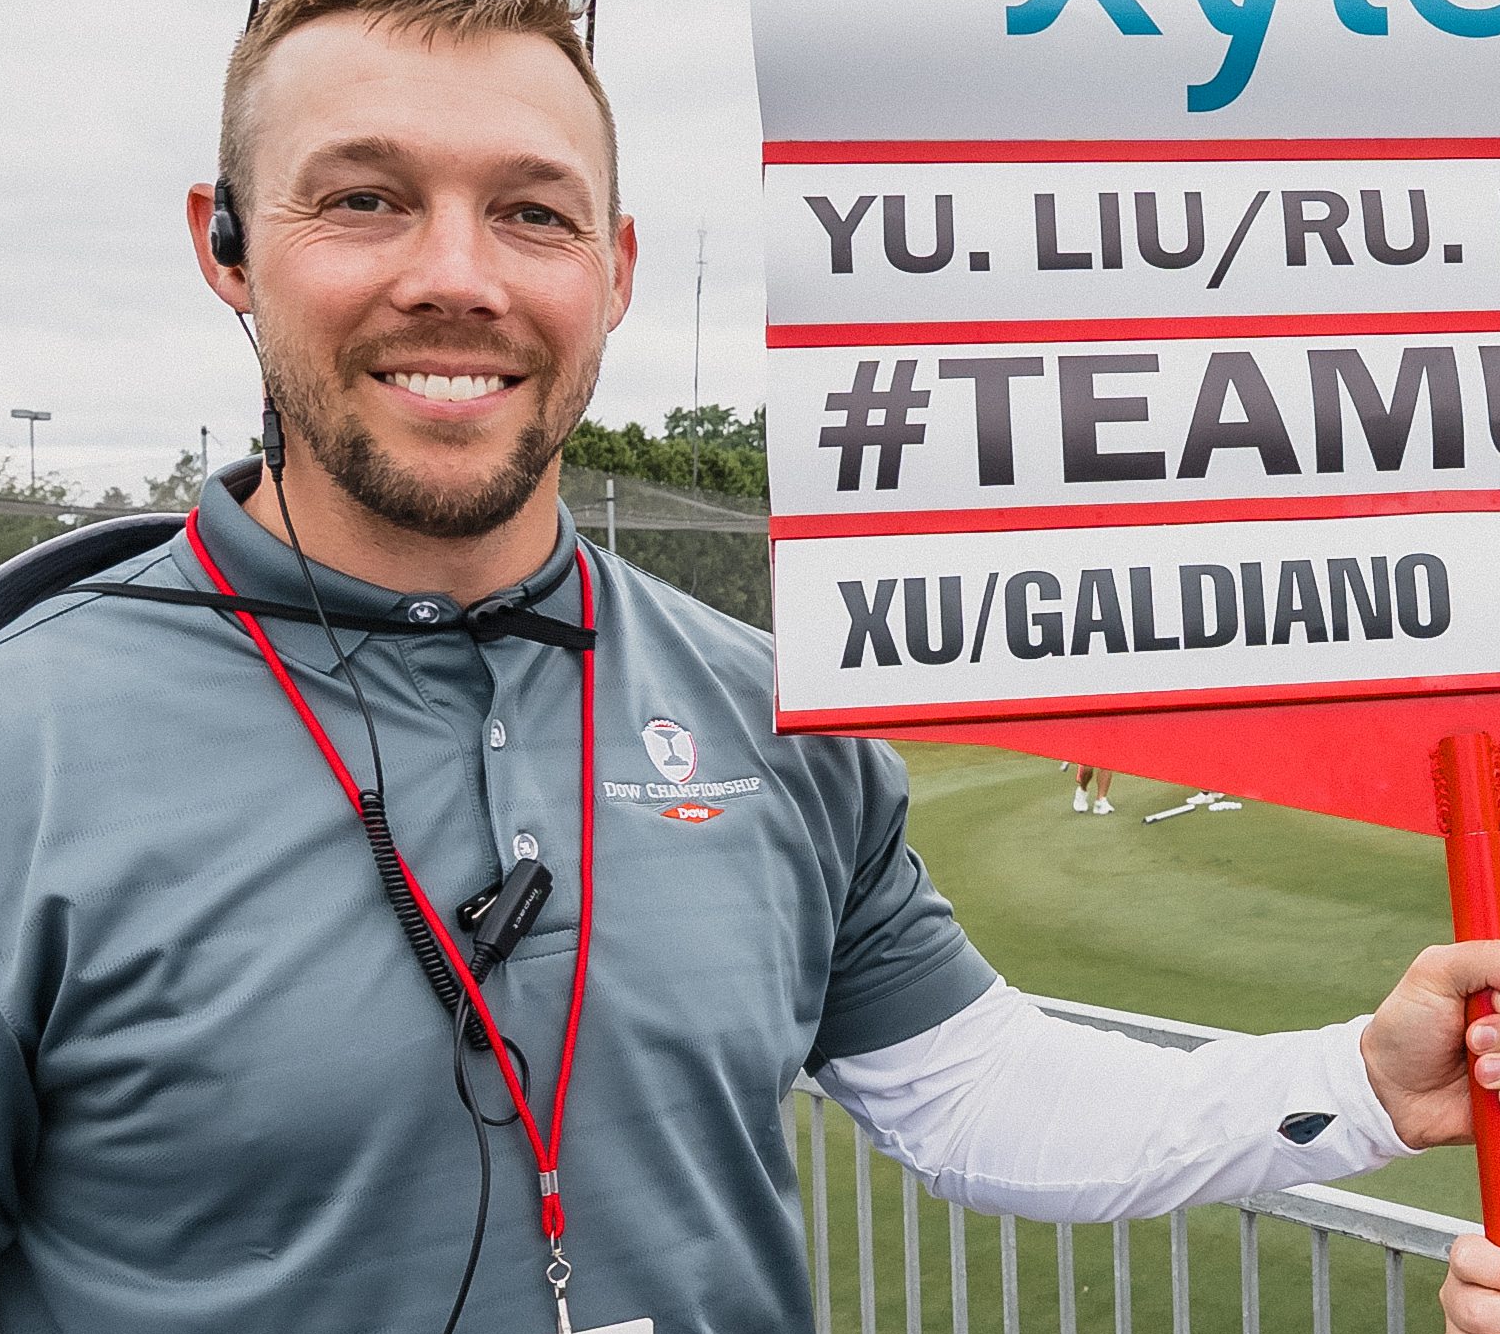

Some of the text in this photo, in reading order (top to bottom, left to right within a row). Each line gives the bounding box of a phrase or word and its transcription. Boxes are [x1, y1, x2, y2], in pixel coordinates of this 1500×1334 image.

[803, 193, 990, 275] YU.
[1034, 188, 1465, 289] LIU/RU.
[837, 552, 1452, 670] XU/GALDIANO
